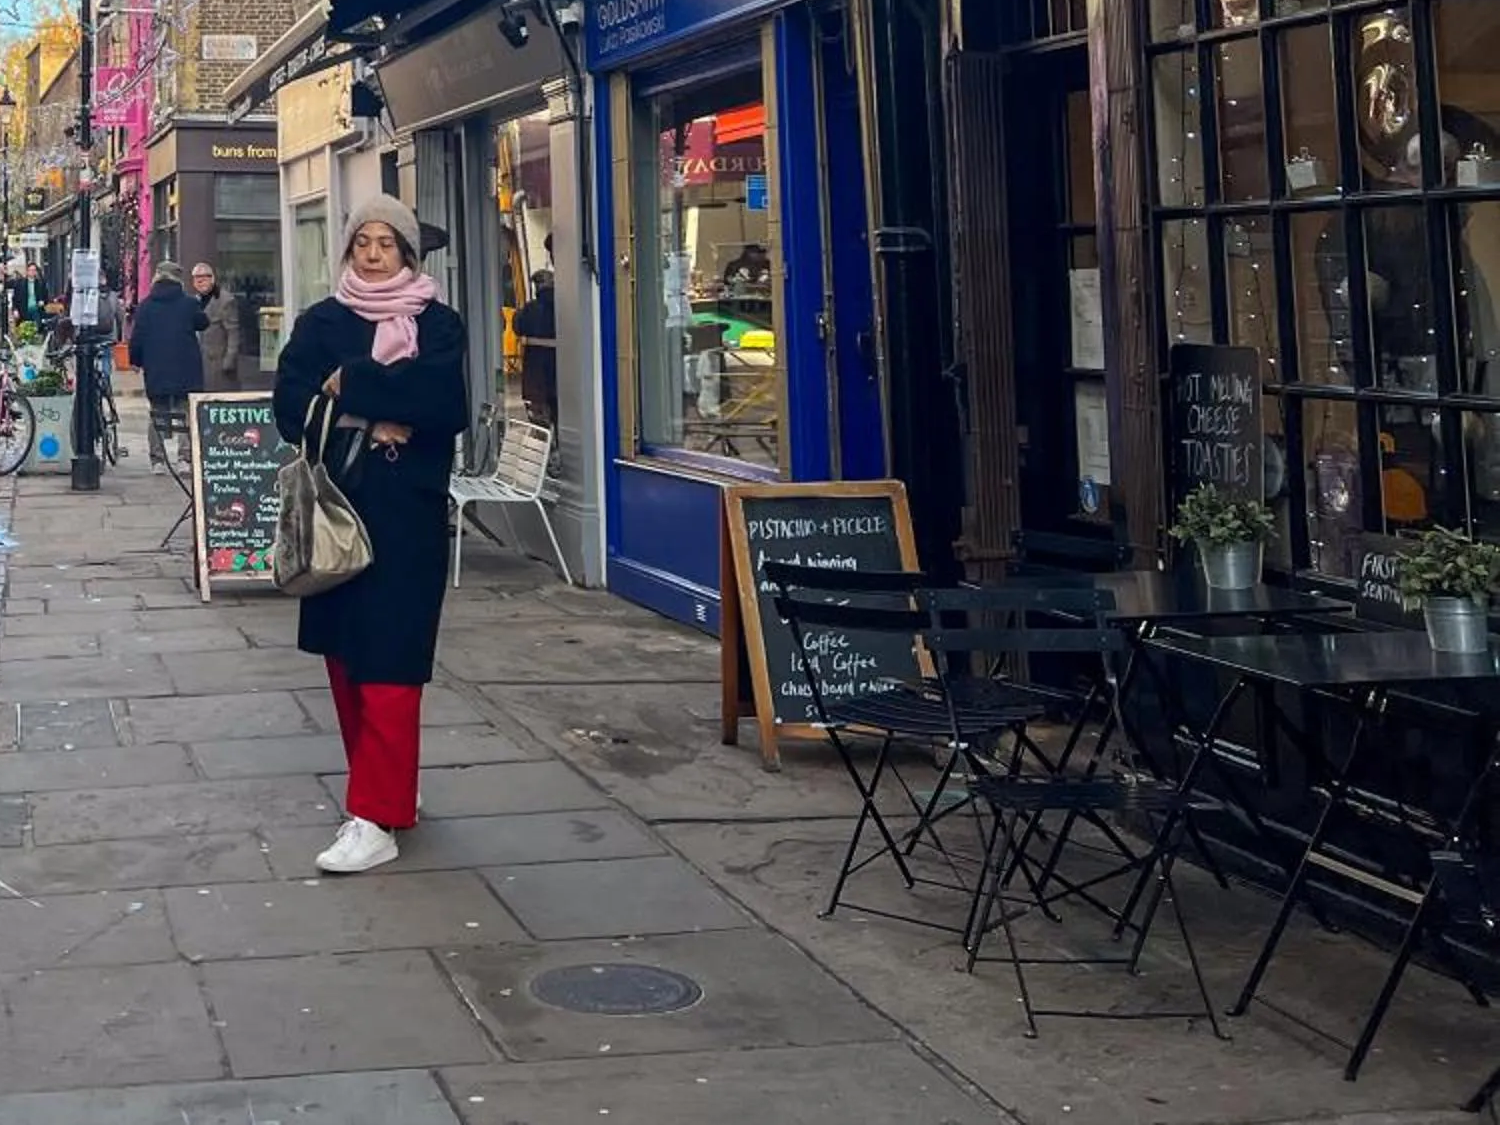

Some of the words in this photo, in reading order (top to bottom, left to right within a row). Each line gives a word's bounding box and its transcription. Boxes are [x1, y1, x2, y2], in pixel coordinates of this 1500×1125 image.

[212, 143, 245, 158] buns
[246, 143, 277, 158] from
[209, 407, 272, 424] FESTIVE
[1187, 404, 1242, 434] CHEESE
[1181, 440, 1255, 487] TOASTIES
[748, 517, 818, 540] PISTACHIO
[819, 520, 829, 534] +
[831, 516, 887, 536] PICKLE
[803, 632, 850, 656] Coffee
[832, 652, 878, 678] Coffee
